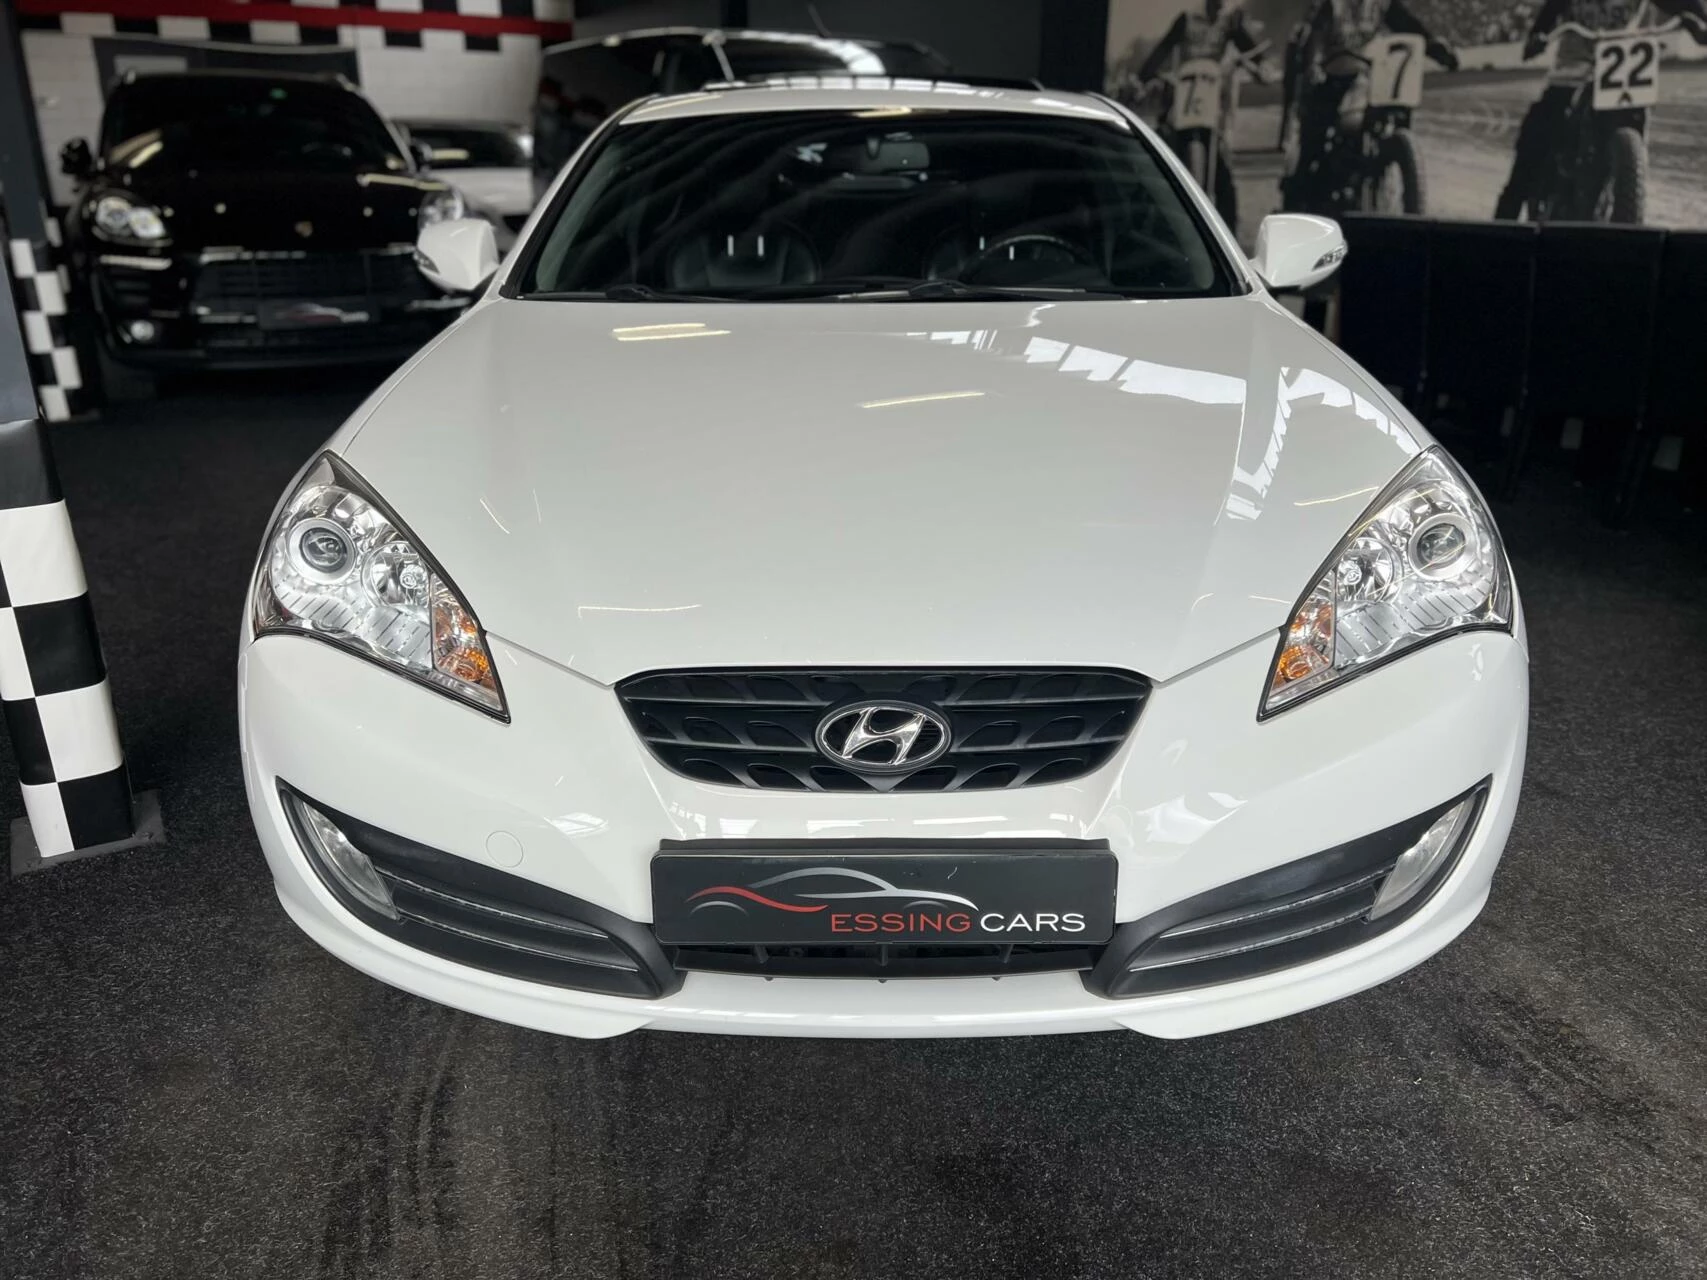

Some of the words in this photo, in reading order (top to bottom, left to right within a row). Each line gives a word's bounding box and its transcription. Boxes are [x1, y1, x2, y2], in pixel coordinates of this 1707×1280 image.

[1387, 43, 1412, 99] 7
[1601, 42, 1654, 90] 22
[831, 913, 972, 933] ESSING
[980, 913, 1086, 933] CARS
